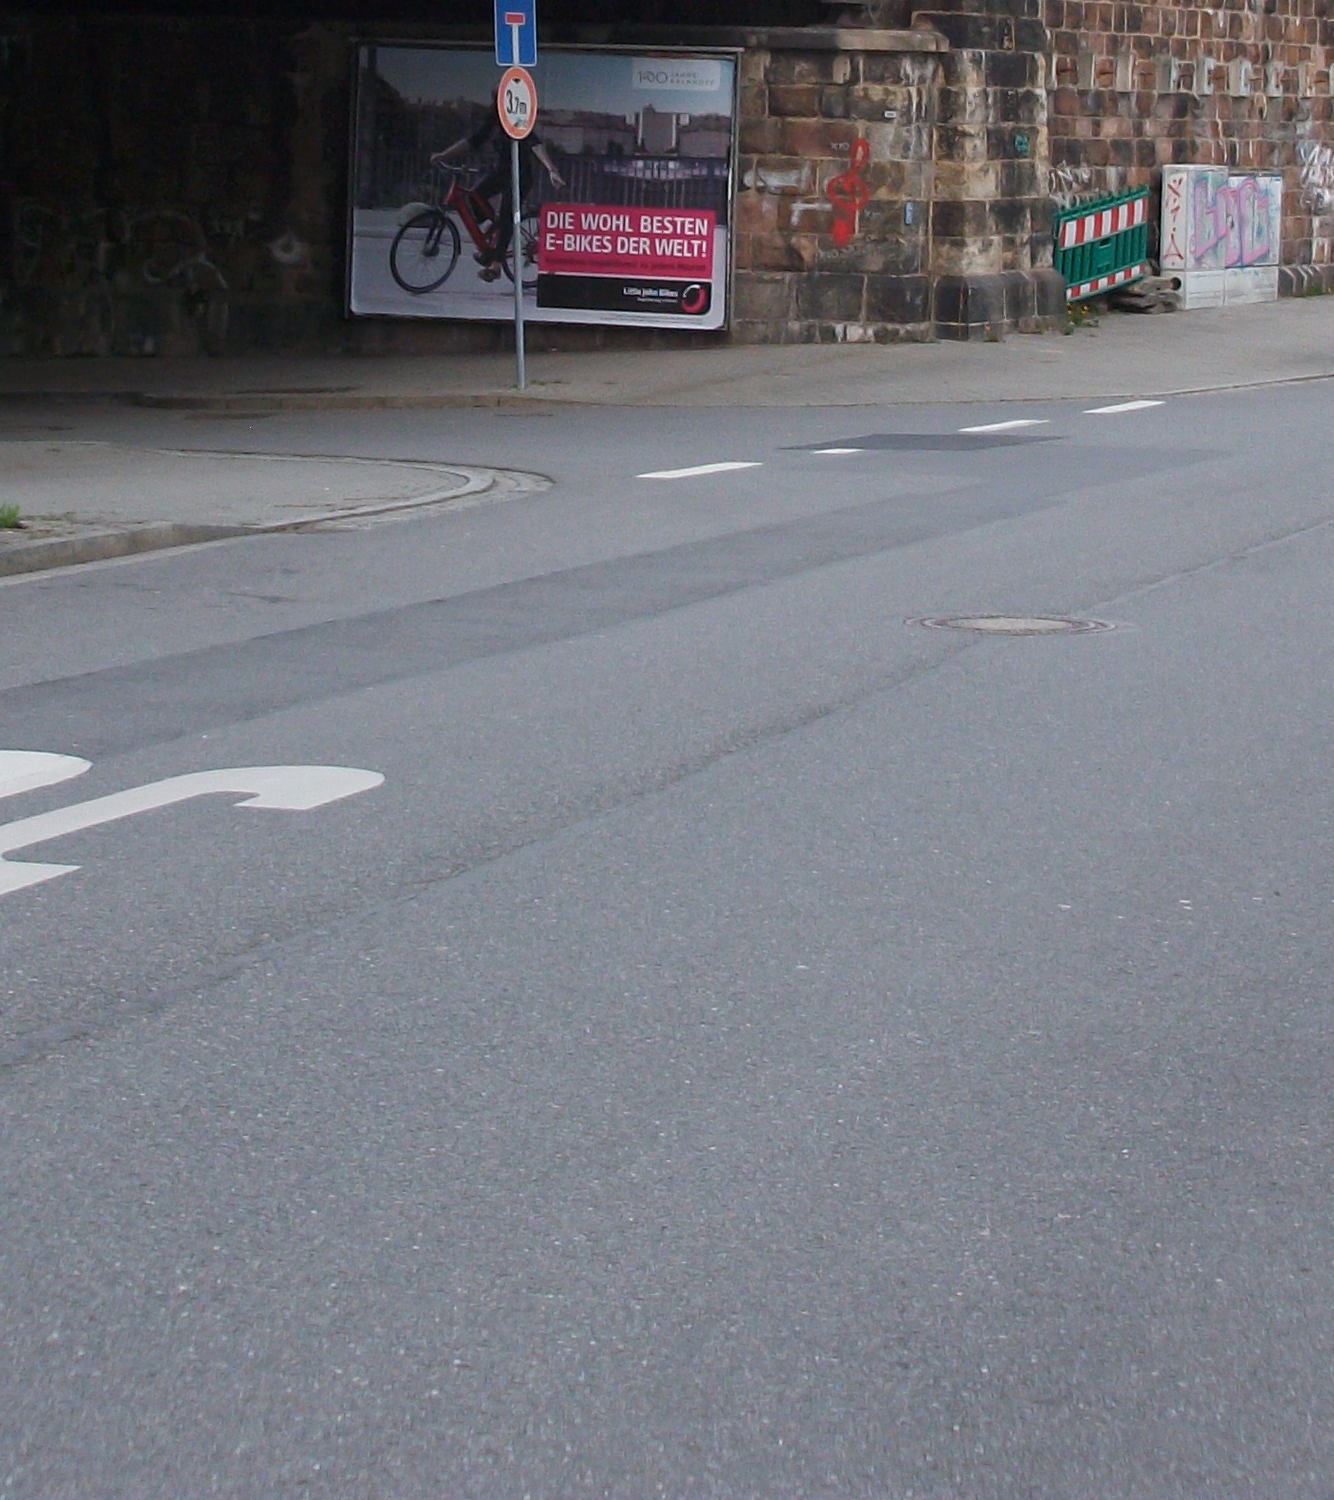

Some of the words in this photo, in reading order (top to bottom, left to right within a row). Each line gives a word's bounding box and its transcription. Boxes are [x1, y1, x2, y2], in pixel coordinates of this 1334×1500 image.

[546, 211, 575, 229] DIE
[580, 212, 634, 233] WOHL
[640, 215, 708, 236] BESTEN
[545, 233, 613, 253] E-BIKES
[617, 237, 651, 255] DER
[655, 238, 707, 258] WELT!
